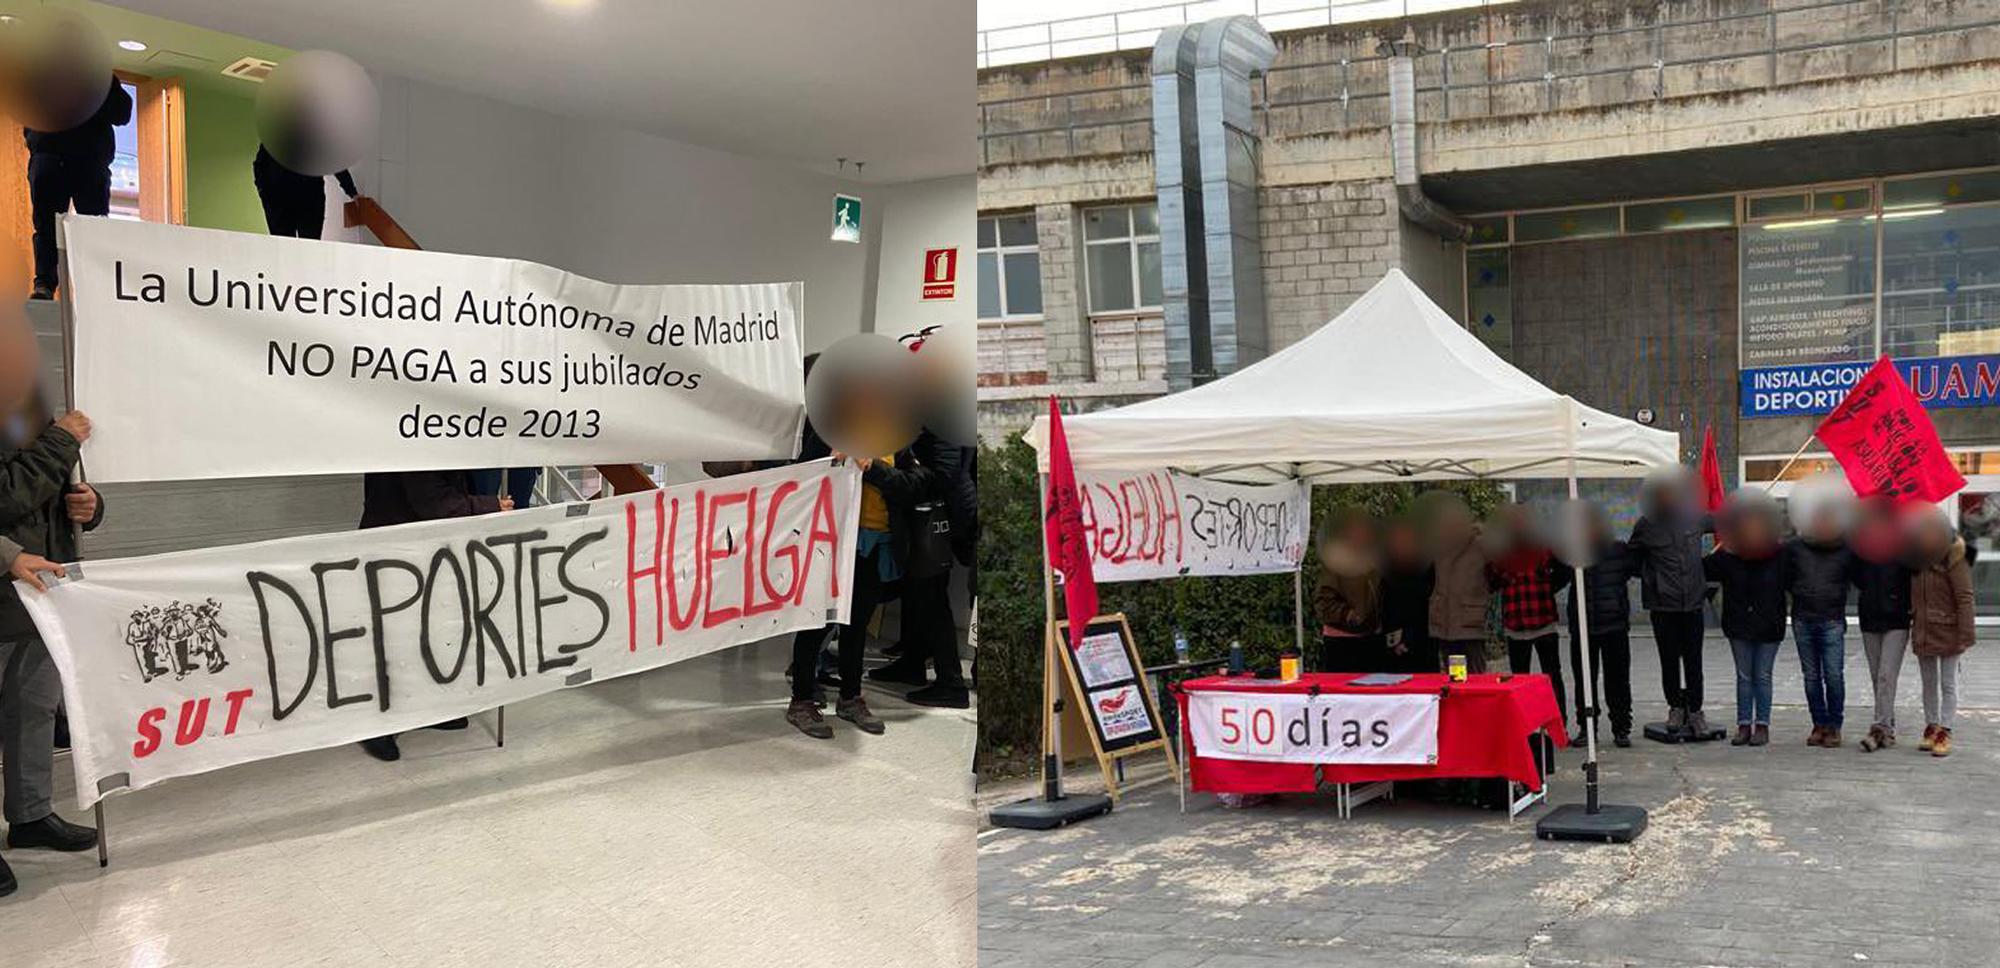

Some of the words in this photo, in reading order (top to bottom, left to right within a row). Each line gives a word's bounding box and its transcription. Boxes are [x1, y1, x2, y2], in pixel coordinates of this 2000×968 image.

[114, 261, 166, 304] La
[187, 267, 442, 323] Universidad
[454, 290, 636, 340] Autónoma
[646, 315, 686, 347] de
[694, 310, 780, 346] Madrid
[924, 288, 953, 296] EXTINTOR
[267, 340, 335, 378] NO
[350, 346, 458, 384] PAGA
[469, 357, 488, 384] a
[500, 357, 552, 385] sus
[560, 353, 702, 393] jubilados
[1755, 366, 1873, 389] INSTALACION
[1910, 362, 2000, 401] UAM
[398, 403, 507, 438] desde
[518, 409, 602, 439] 2013
[246, 525, 610, 721] DEPORTES
[625, 475, 840, 652] HUELGA
[133, 688, 254, 759] SUT
[1220, 707, 1275, 746] 50
[1287, 706, 1390, 748] días
